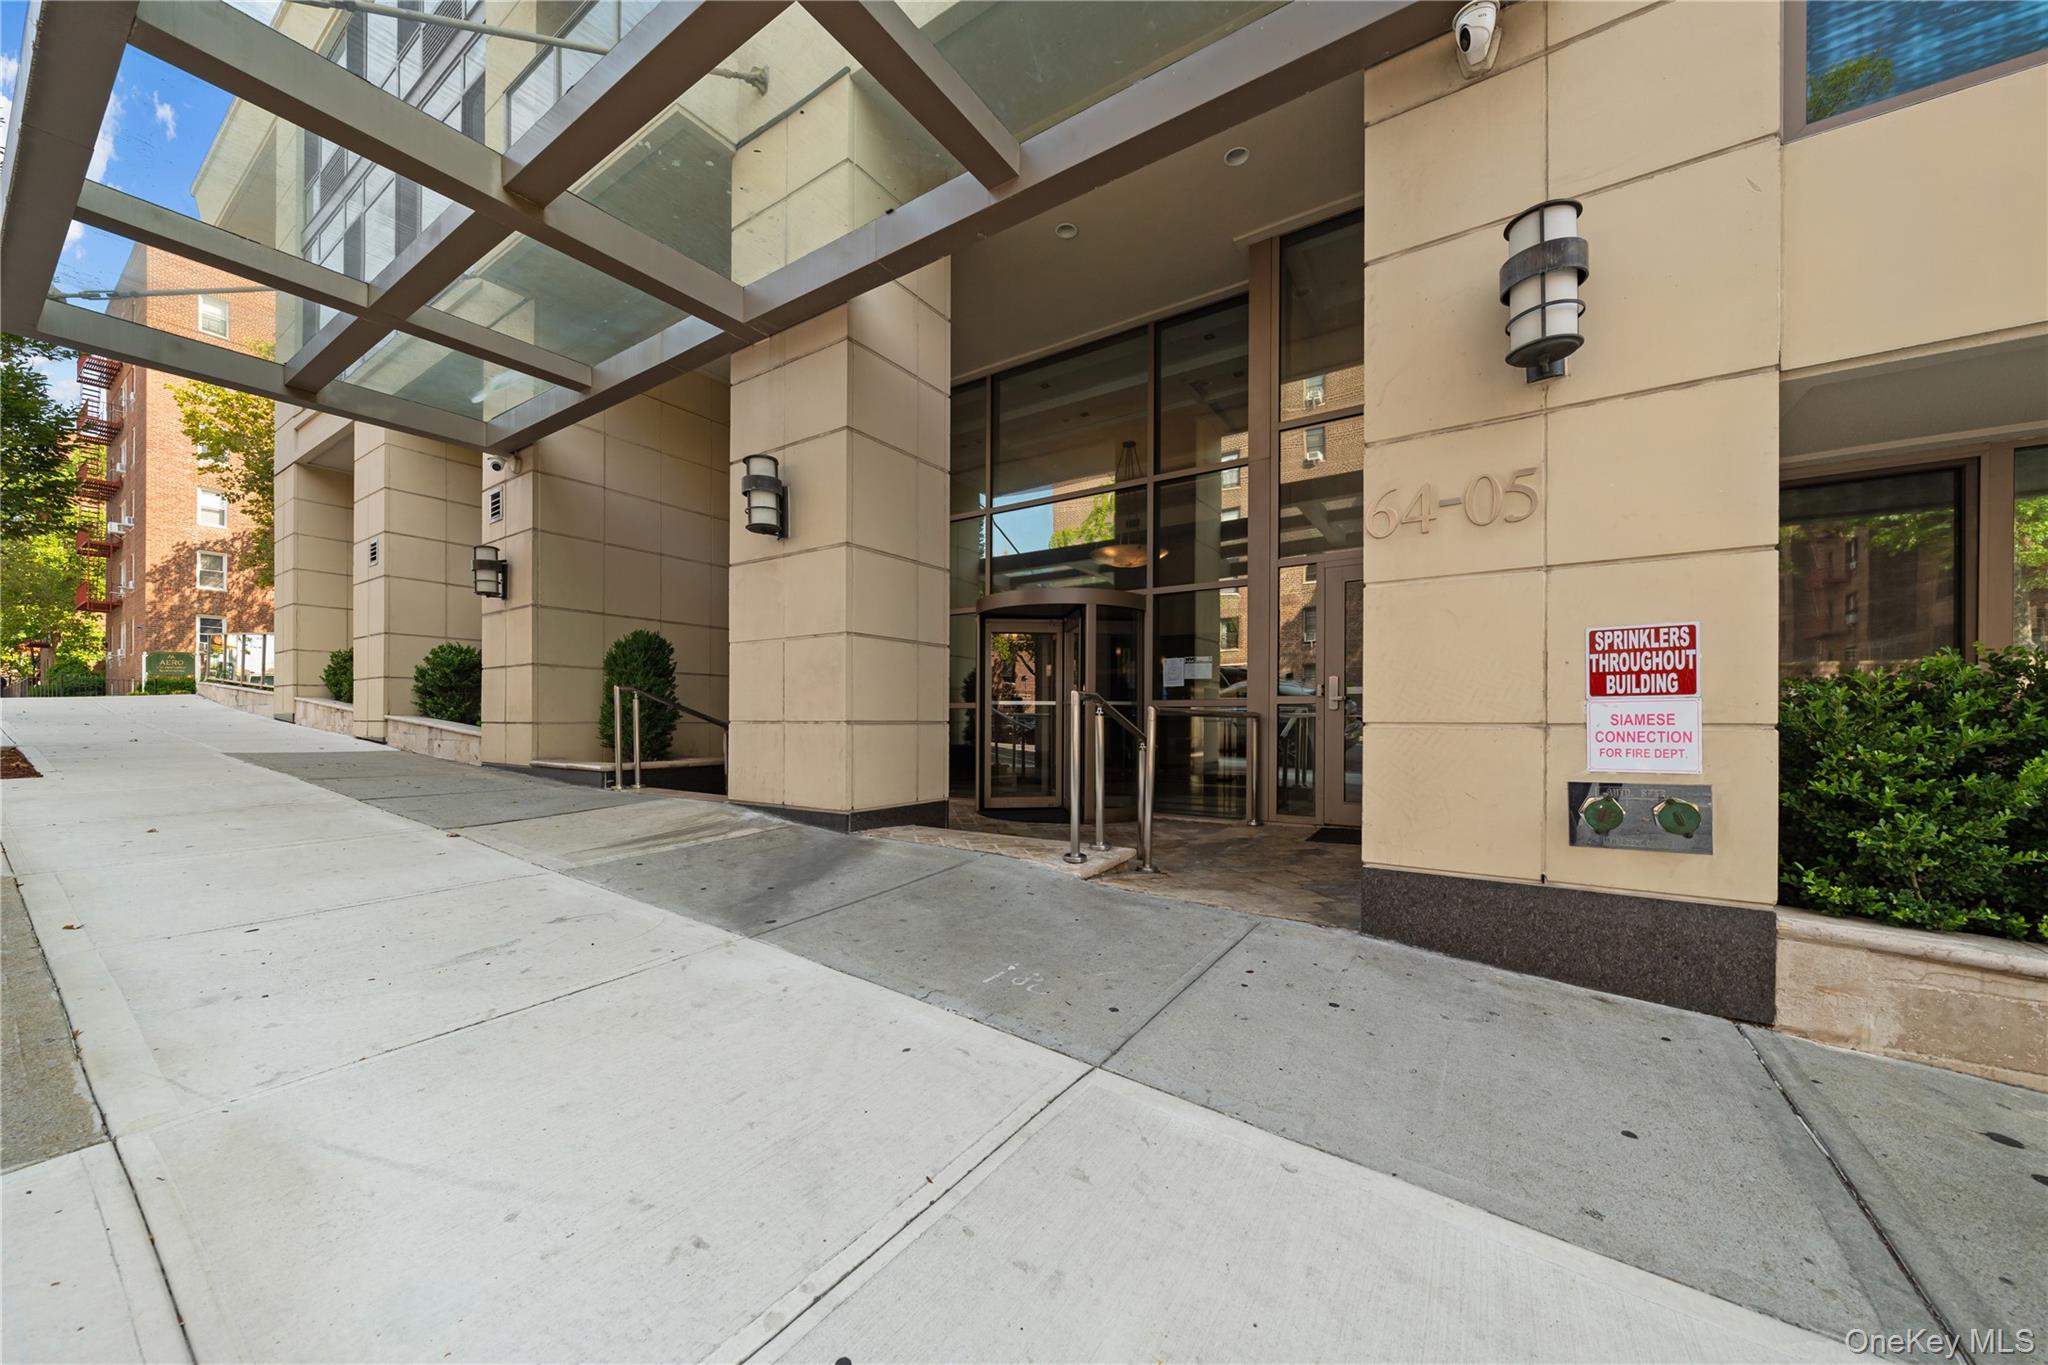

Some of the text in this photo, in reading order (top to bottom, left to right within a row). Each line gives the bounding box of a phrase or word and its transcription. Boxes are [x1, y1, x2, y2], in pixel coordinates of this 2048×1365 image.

[1365, 467, 1539, 539] 64-05
[1595, 626, 1690, 651] SPRINKLERS
[1590, 649, 1696, 673] THROUGHOUT
[1606, 673, 1679, 694] BUILDING
[1610, 713, 1676, 726] SIAMESE
[1595, 731, 1692, 743] CONNECTION
[1600, 748, 1622, 758] FOR
[1626, 748, 1651, 758] FIRE
